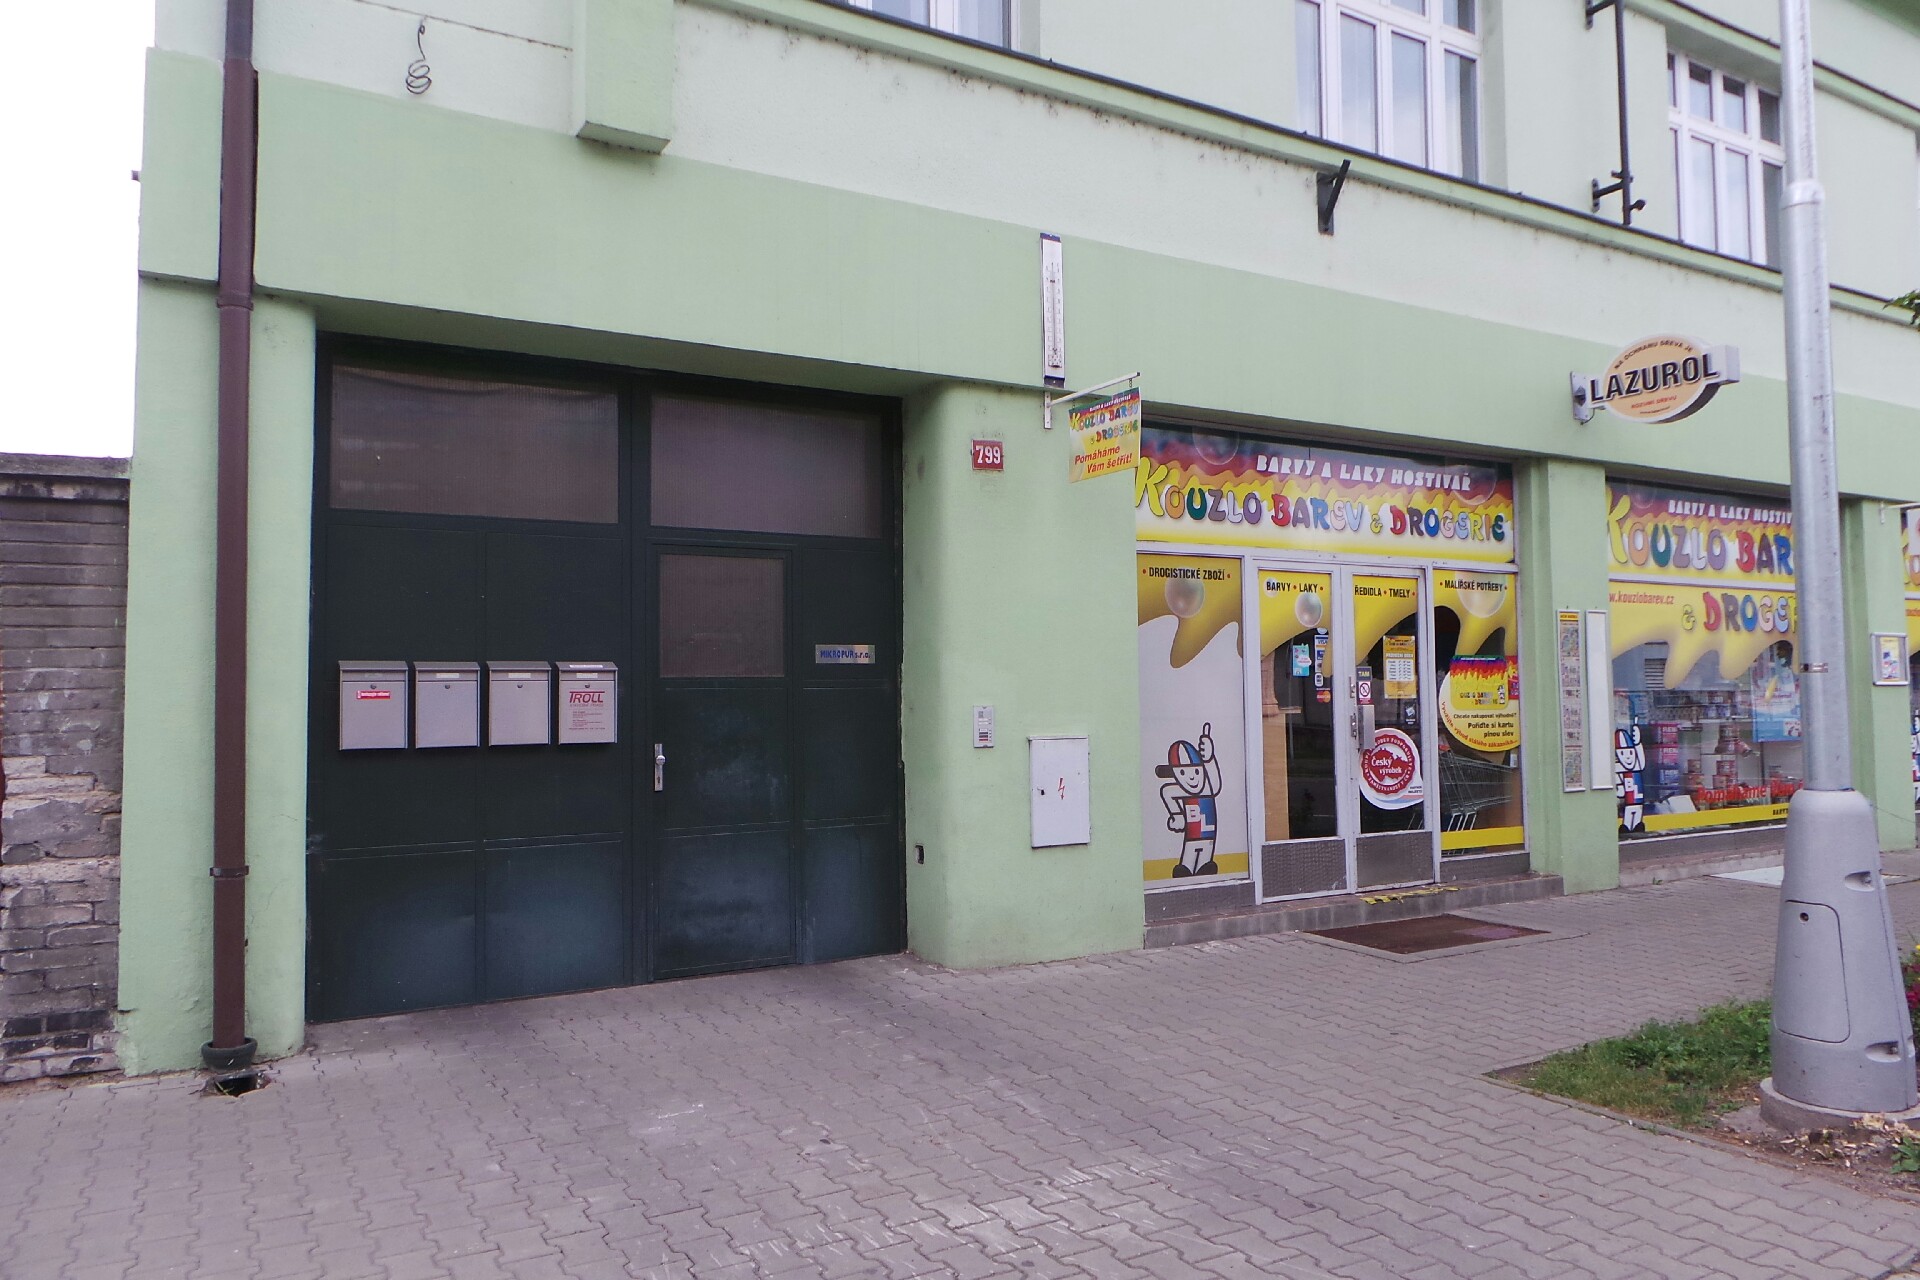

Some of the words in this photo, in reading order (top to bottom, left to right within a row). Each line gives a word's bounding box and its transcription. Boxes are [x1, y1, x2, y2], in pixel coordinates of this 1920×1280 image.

[1590, 353, 1719, 402] LAZUROL
[1070, 412, 1106, 432] KOUZLO
[1108, 402, 1139, 421] BAREV
[1096, 419, 1139, 442] DROGERIE
[976, 445, 1001, 464] 799
[1074, 445, 1120, 465] Pomáháme
[1087, 461, 1105, 474] Vám
[1257, 455, 1316, 476] BARVY
[1321, 462, 1332, 478] A
[1339, 463, 1385, 483] LAKY
[1391, 468, 1471, 491] HOSTIVAŘ
[1135, 456, 1262, 525] KOUZLO
[1271, 493, 1364, 532] BAREV
[1389, 504, 1506, 542] DROGERIE
[1668, 500, 1706, 516] BARVY
[1708, 504, 1716, 517] A
[1720, 505, 1750, 520] LAKY
[1753, 508, 1792, 524] HOSTIV
[1606, 486, 1728, 571] KOUZLO
[1736, 529, 1794, 576] BAR
[1149, 567, 1201, 580] DROGISTICKÉ
[1202, 568, 1226, 581] ZBOŽÍ
[1266, 581, 1291, 592] BARVY
[1299, 582, 1318, 593] LAKY
[1354, 585, 1382, 597] ŘEDIDLA
[1388, 588, 1411, 598] TMELY
[1444, 579, 1475, 591] MALÍŘSKÉ
[1476, 581, 1503, 592] POTŘEBY
[820, 650, 854, 659] MIKROPUR
[569, 691, 605, 703] TROLL
[1498, 720, 1514, 728] kartu
[1483, 730, 1501, 738] plnou
[1371, 756, 1393, 768] Český
[1380, 766, 1402, 776] výrobek
[1185, 805, 1215, 832] BL
